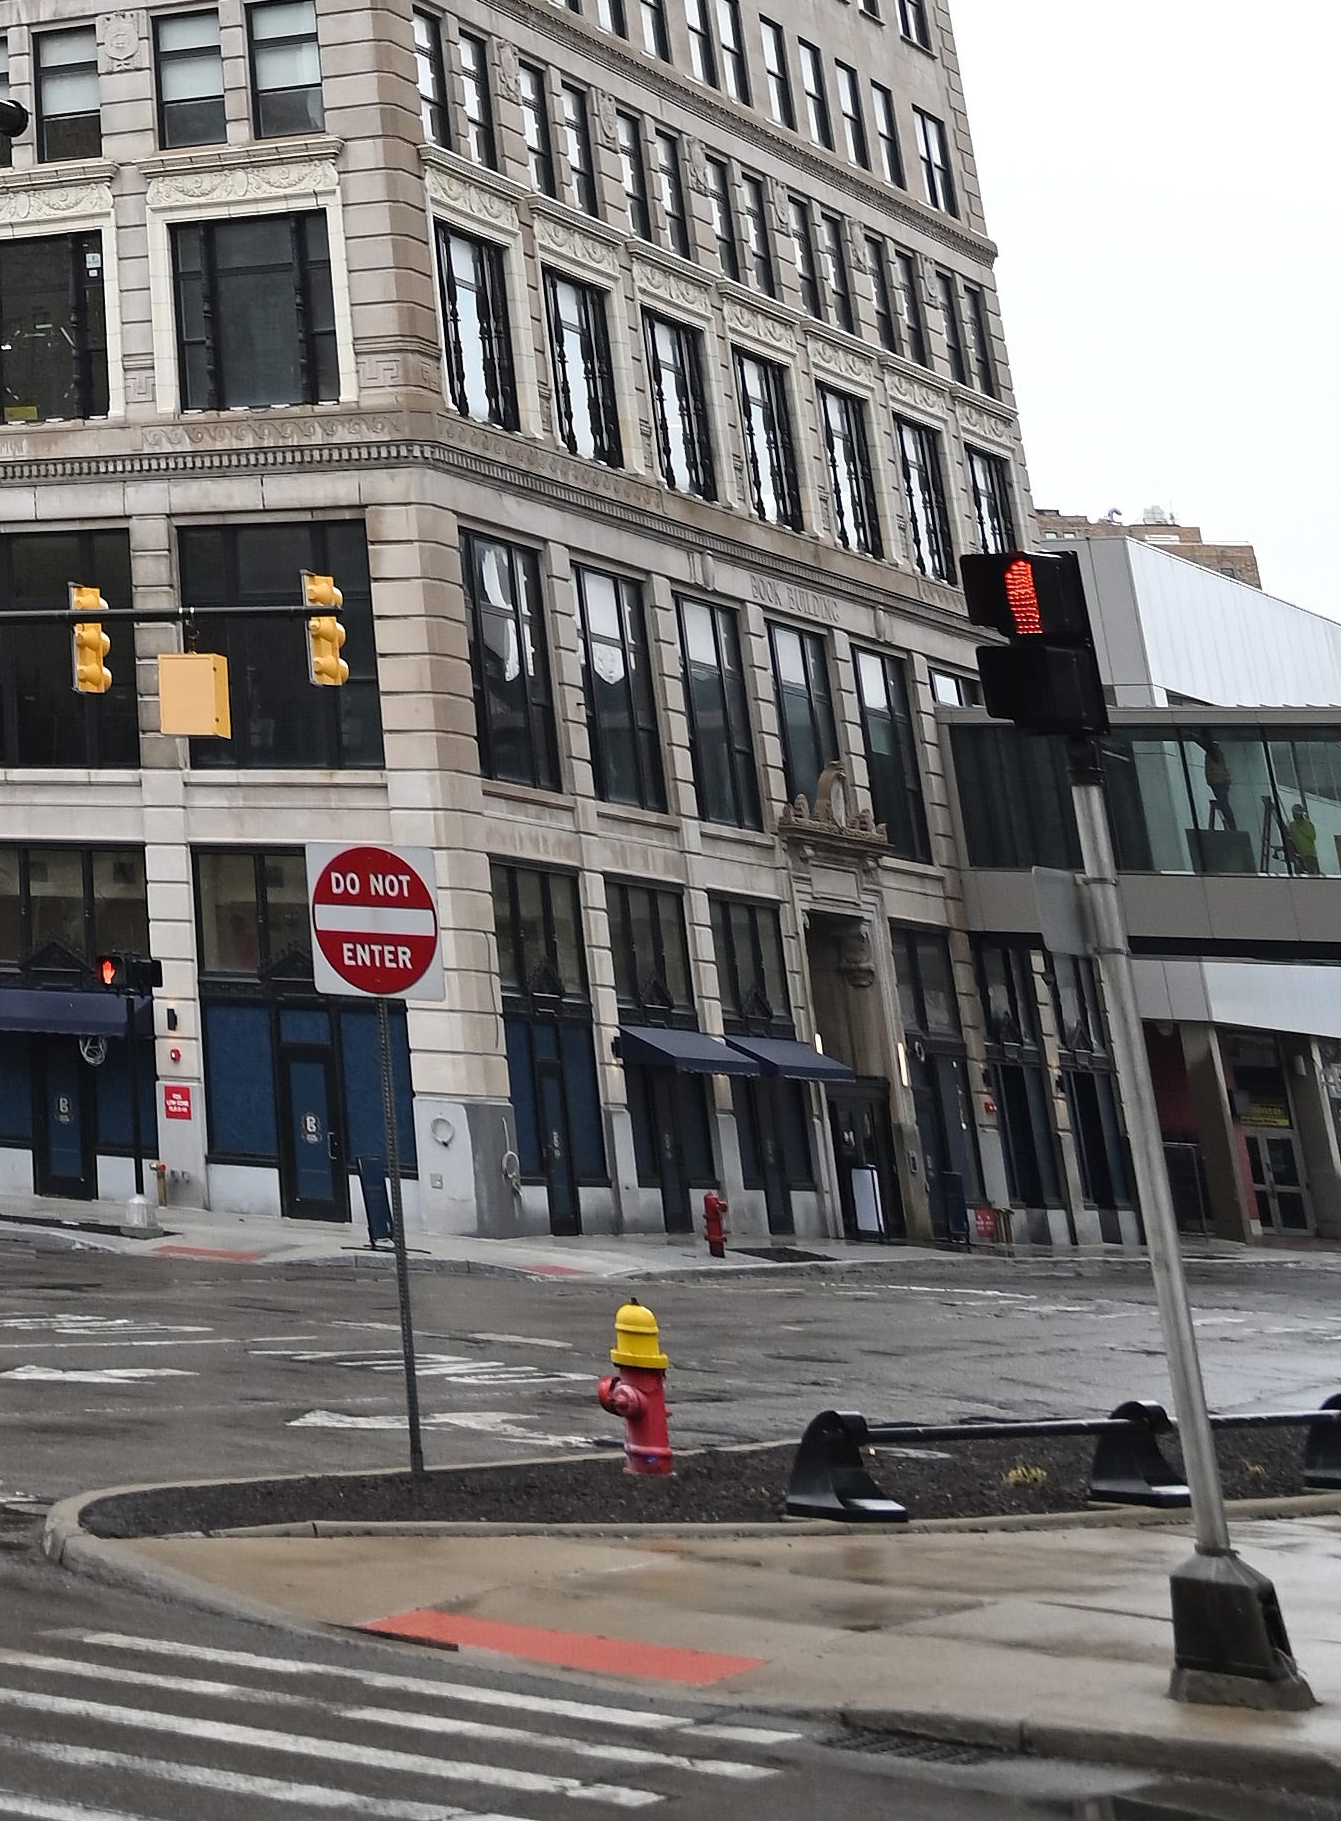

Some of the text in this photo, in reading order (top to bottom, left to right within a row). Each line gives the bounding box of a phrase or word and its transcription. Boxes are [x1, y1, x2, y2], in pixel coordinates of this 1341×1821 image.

[749, 573, 783, 607] BOOK
[330, 871, 411, 897] DO NOT
[342, 942, 413, 970] ENTER
